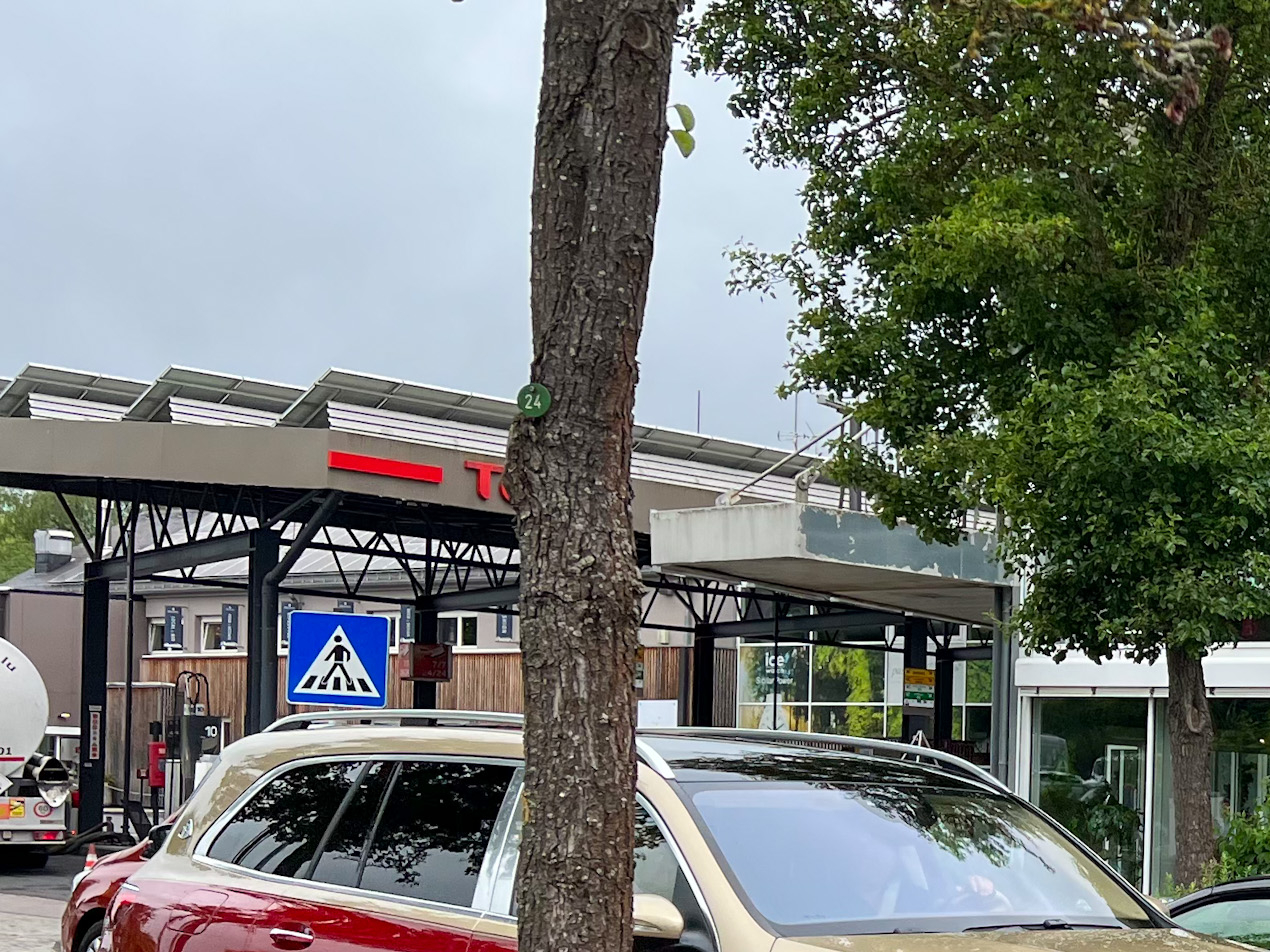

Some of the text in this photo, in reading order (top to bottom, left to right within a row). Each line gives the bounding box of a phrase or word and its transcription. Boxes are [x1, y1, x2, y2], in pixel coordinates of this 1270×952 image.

[524, 393, 542, 410] 24
[765, 651, 785, 667] ice
[204, 725, 218, 738] 10
